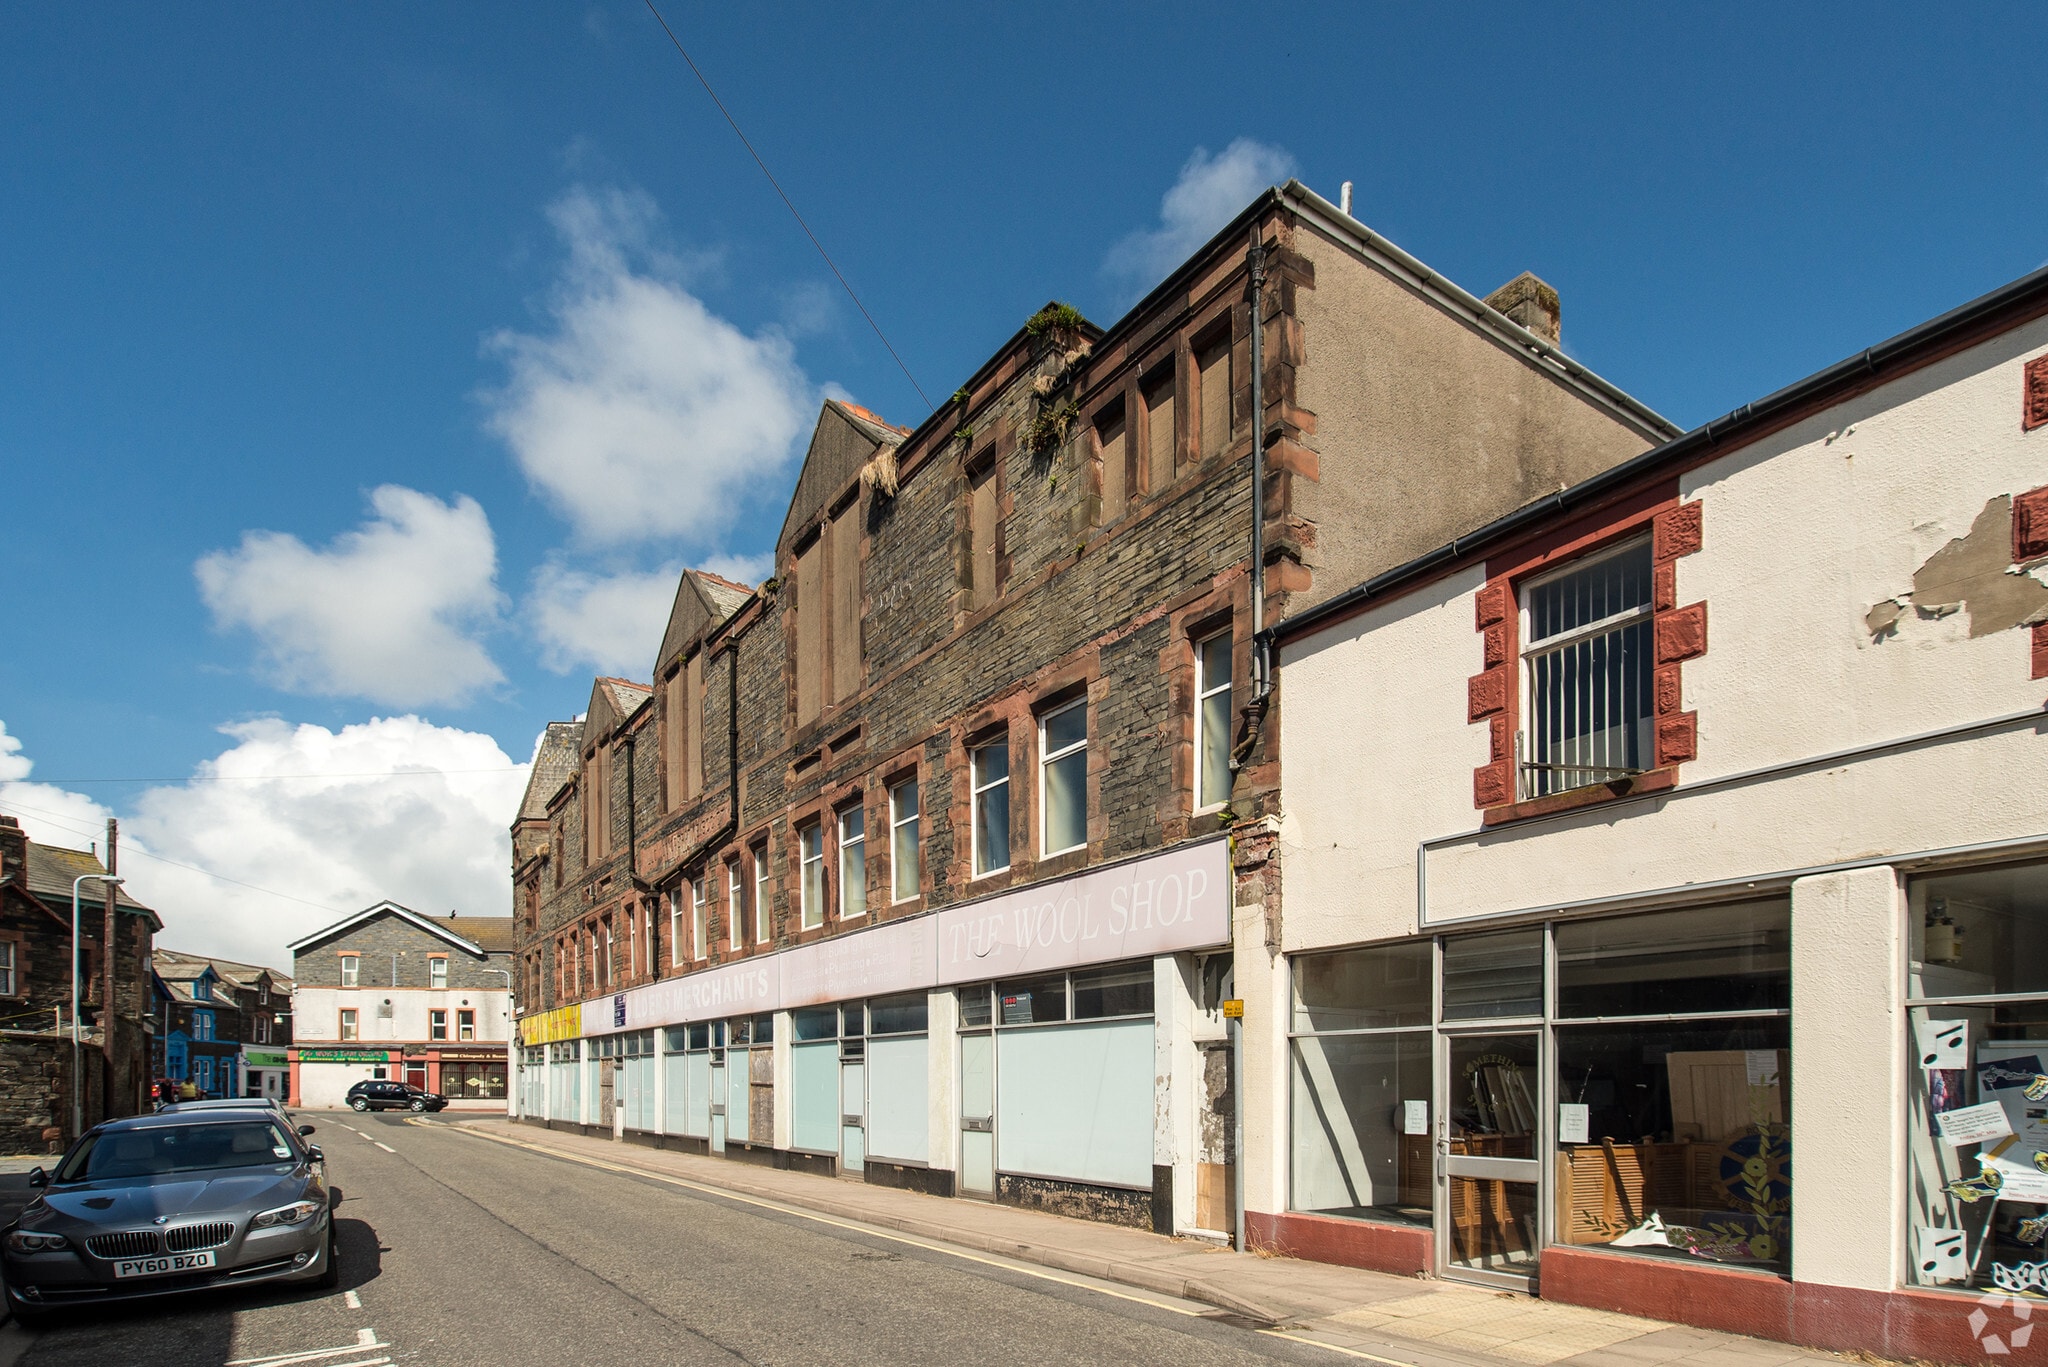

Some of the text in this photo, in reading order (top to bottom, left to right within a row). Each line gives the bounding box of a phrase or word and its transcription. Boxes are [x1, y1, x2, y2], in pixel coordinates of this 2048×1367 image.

[948, 868, 1208, 964] THE WOOL SHOP
[673, 968, 769, 1011] MERCHANTS
[121, 1254, 208, 1275] PY60 BZO
